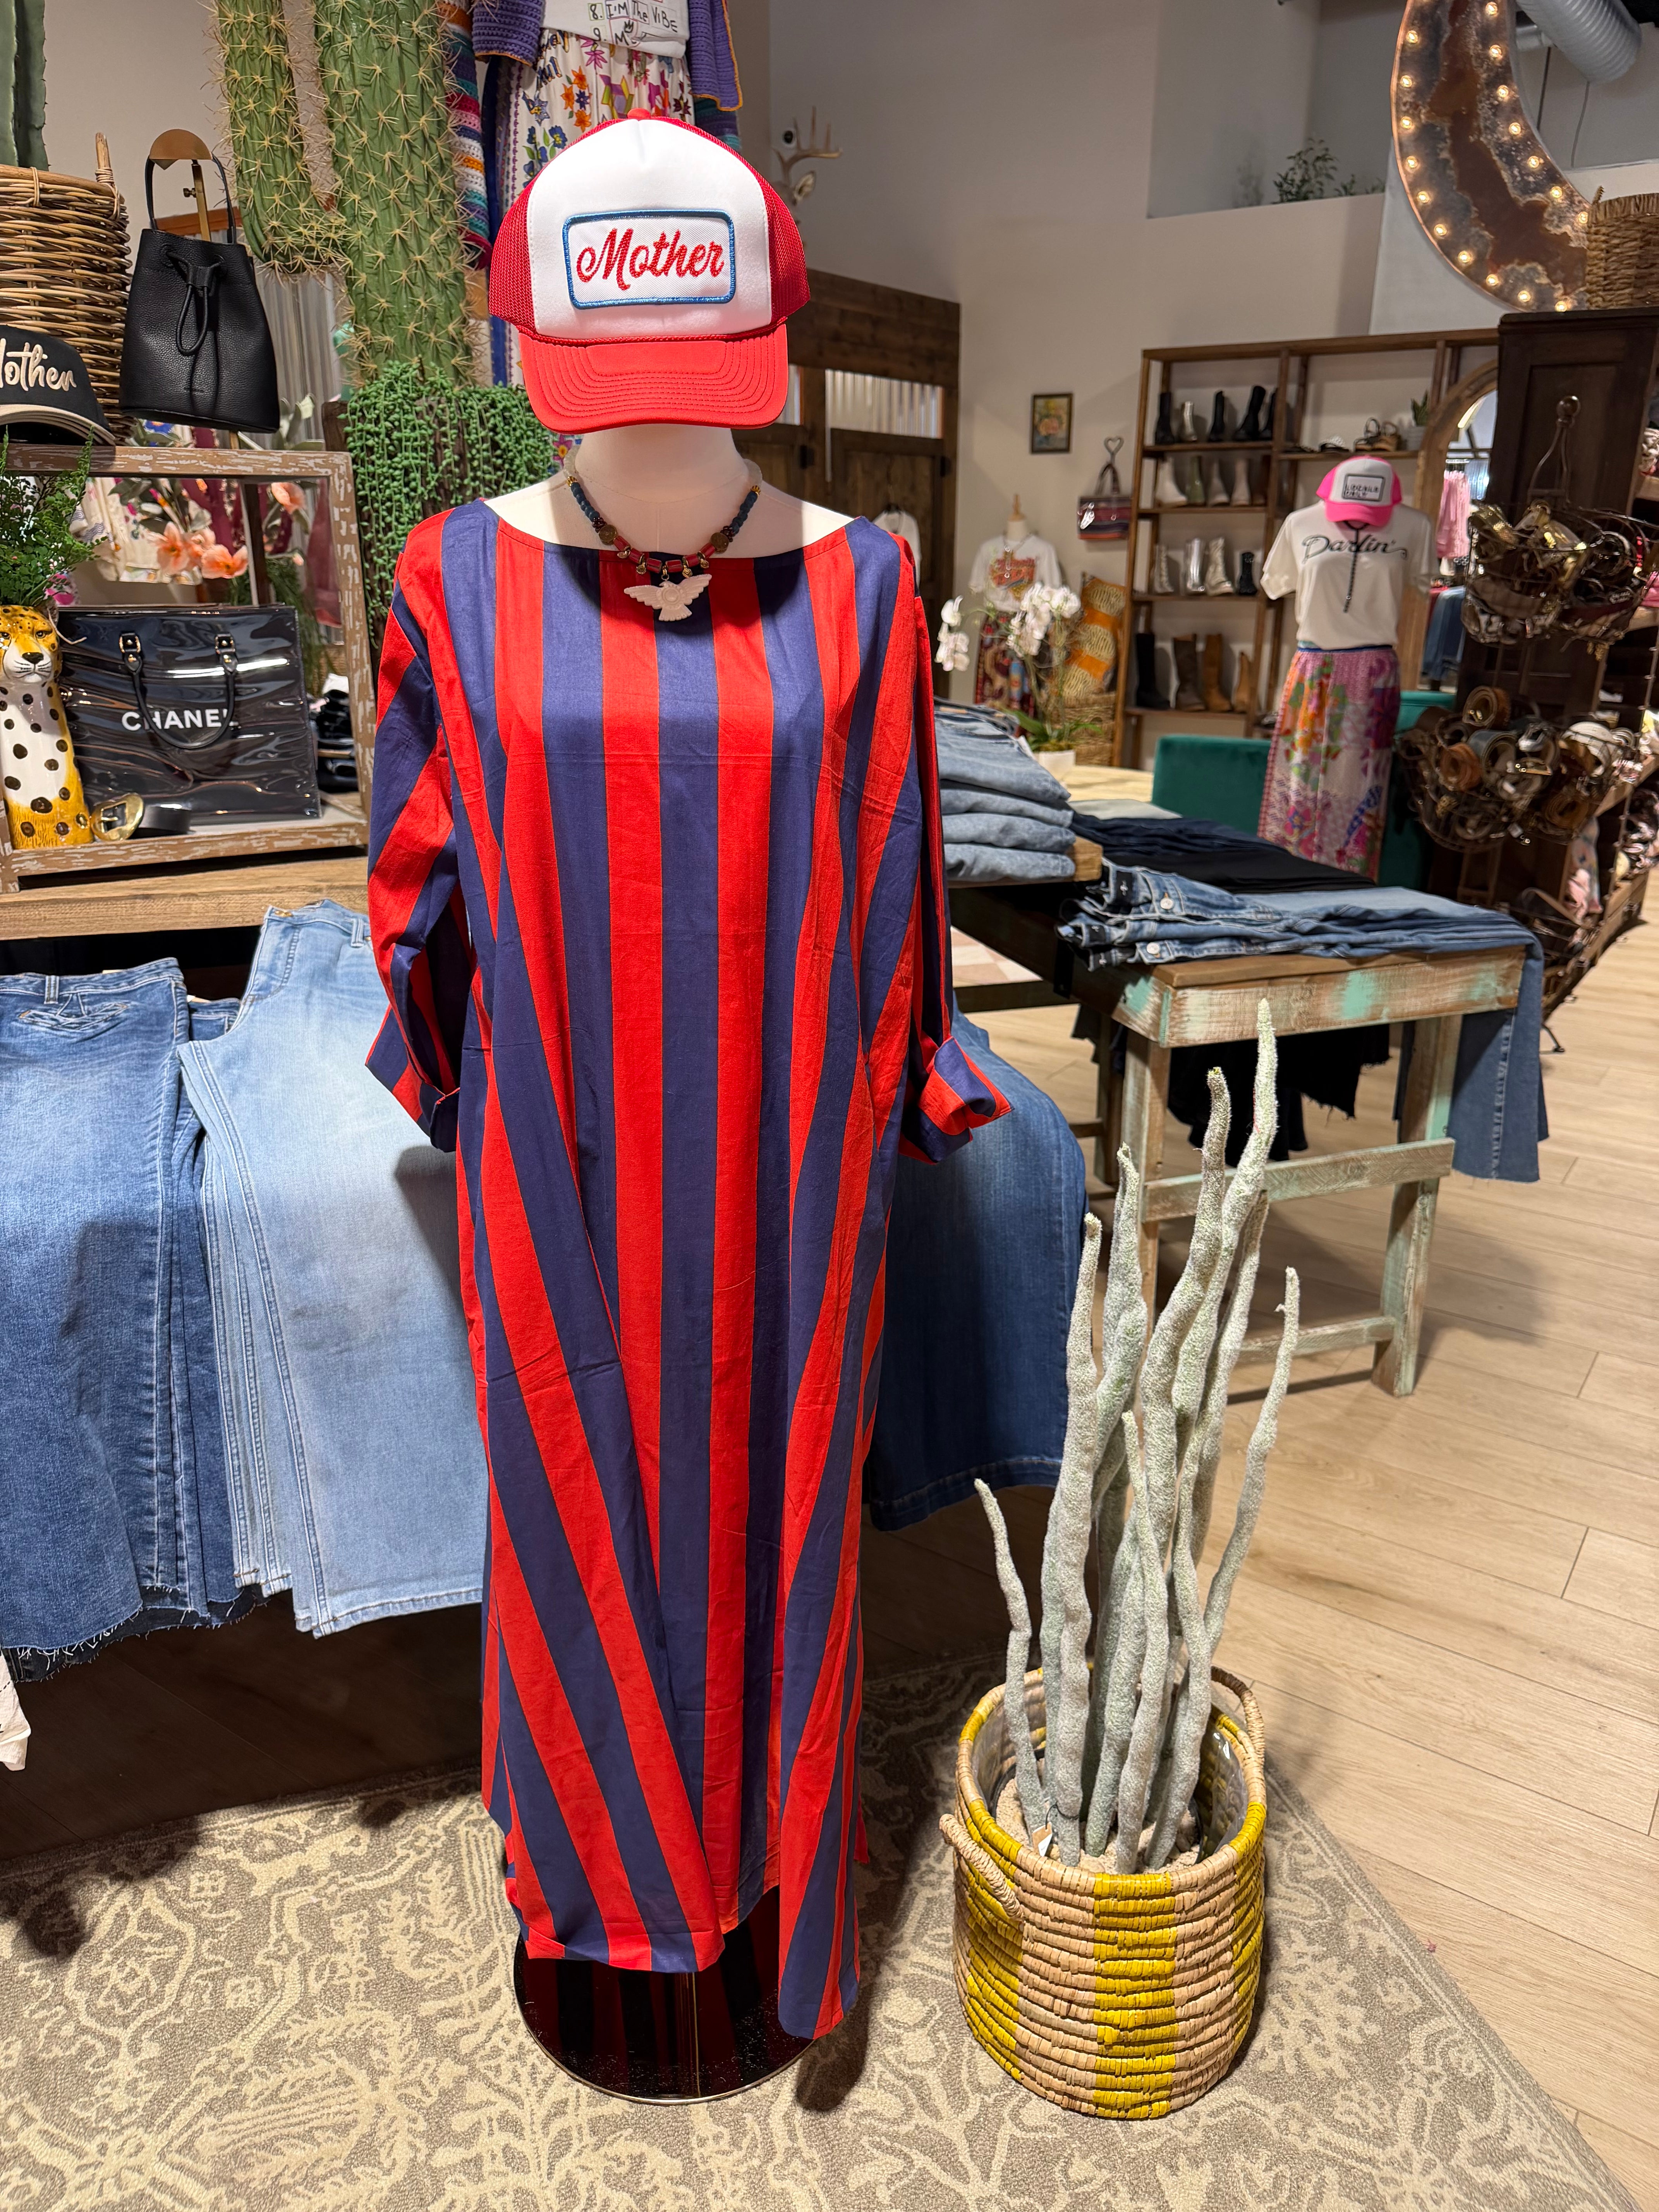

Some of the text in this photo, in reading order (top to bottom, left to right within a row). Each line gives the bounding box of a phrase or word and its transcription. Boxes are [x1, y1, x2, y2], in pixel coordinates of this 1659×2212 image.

[590, 4, 603, 19] 8.
[606, 2, 629, 17] I'M
[576, 228, 724, 291] Mother
[0, 338, 77, 392] other
